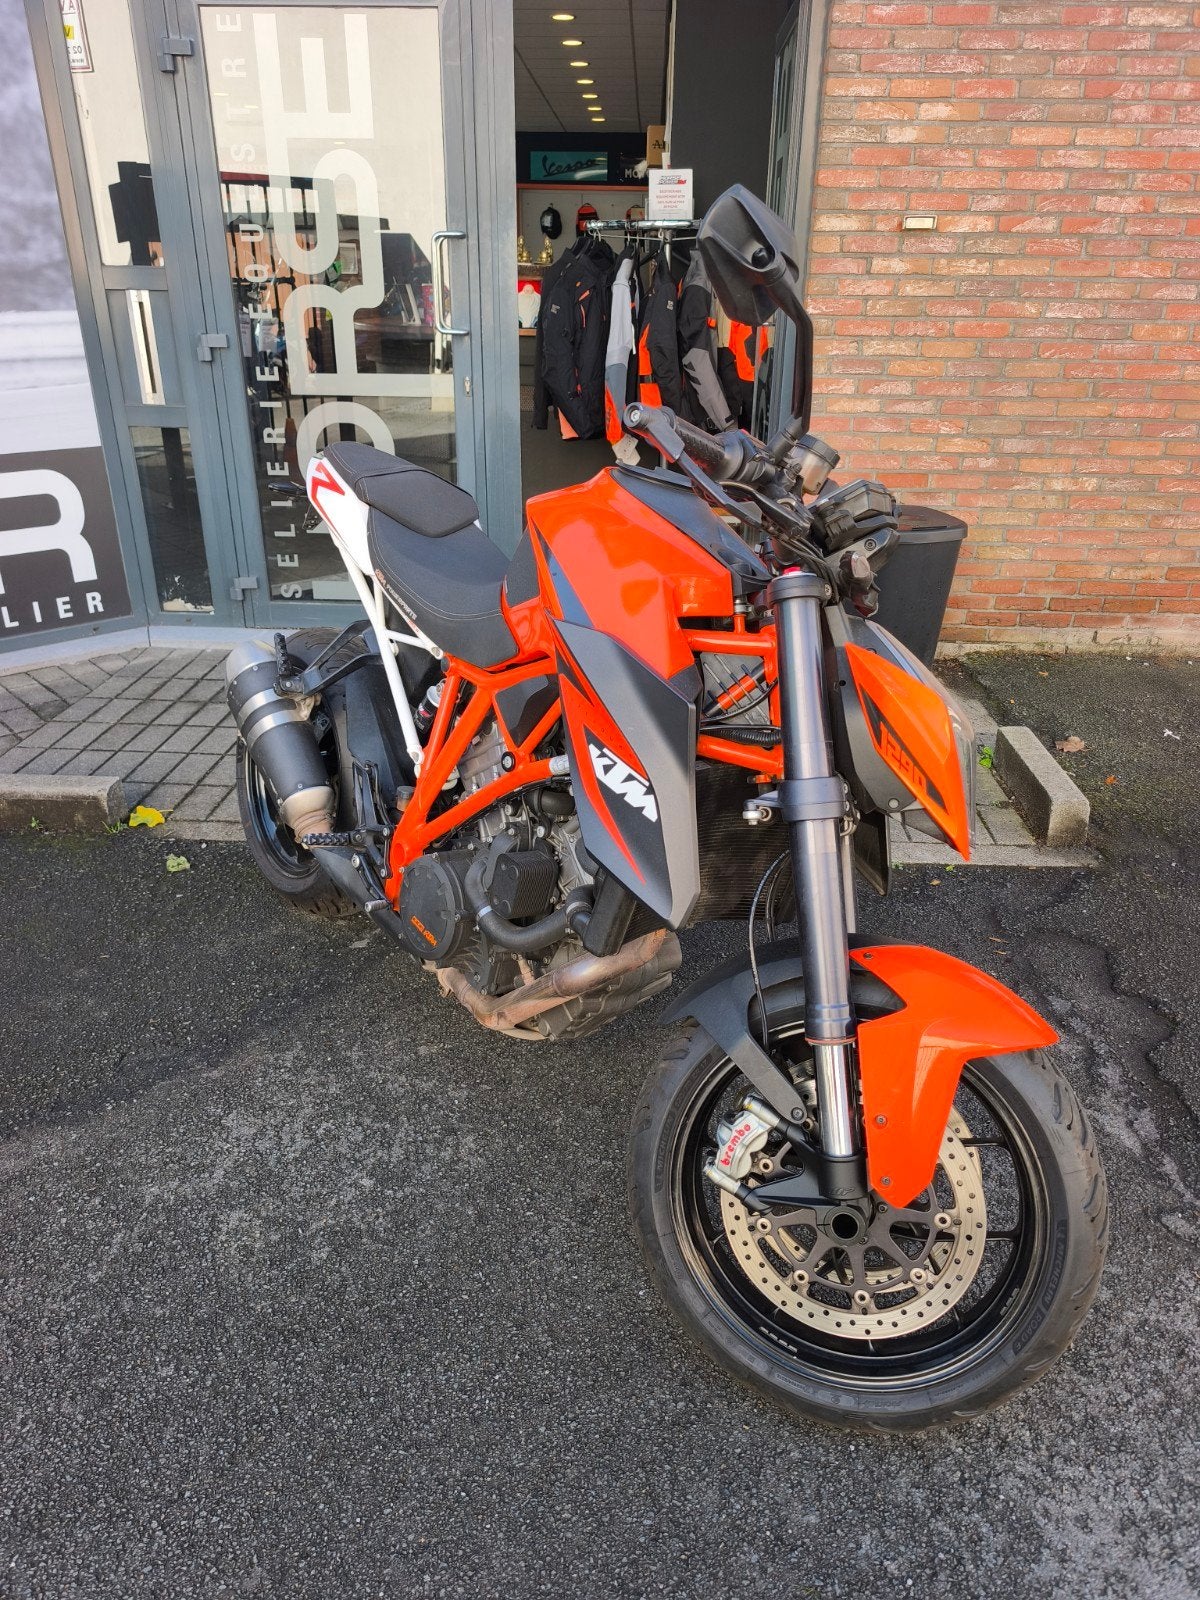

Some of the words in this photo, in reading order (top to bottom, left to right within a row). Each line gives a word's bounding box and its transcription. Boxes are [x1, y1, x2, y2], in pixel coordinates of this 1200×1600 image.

[541, 155, 598, 177] Vespa
[256, 366, 302, 599] SELLERIE
[1, 591, 105, 629] LIER
[588, 743, 658, 823] KTM
[880, 721, 928, 798] 1290
[720, 1123, 752, 1166] brembo
[1044, 1240, 1067, 1306] MICHELIN
